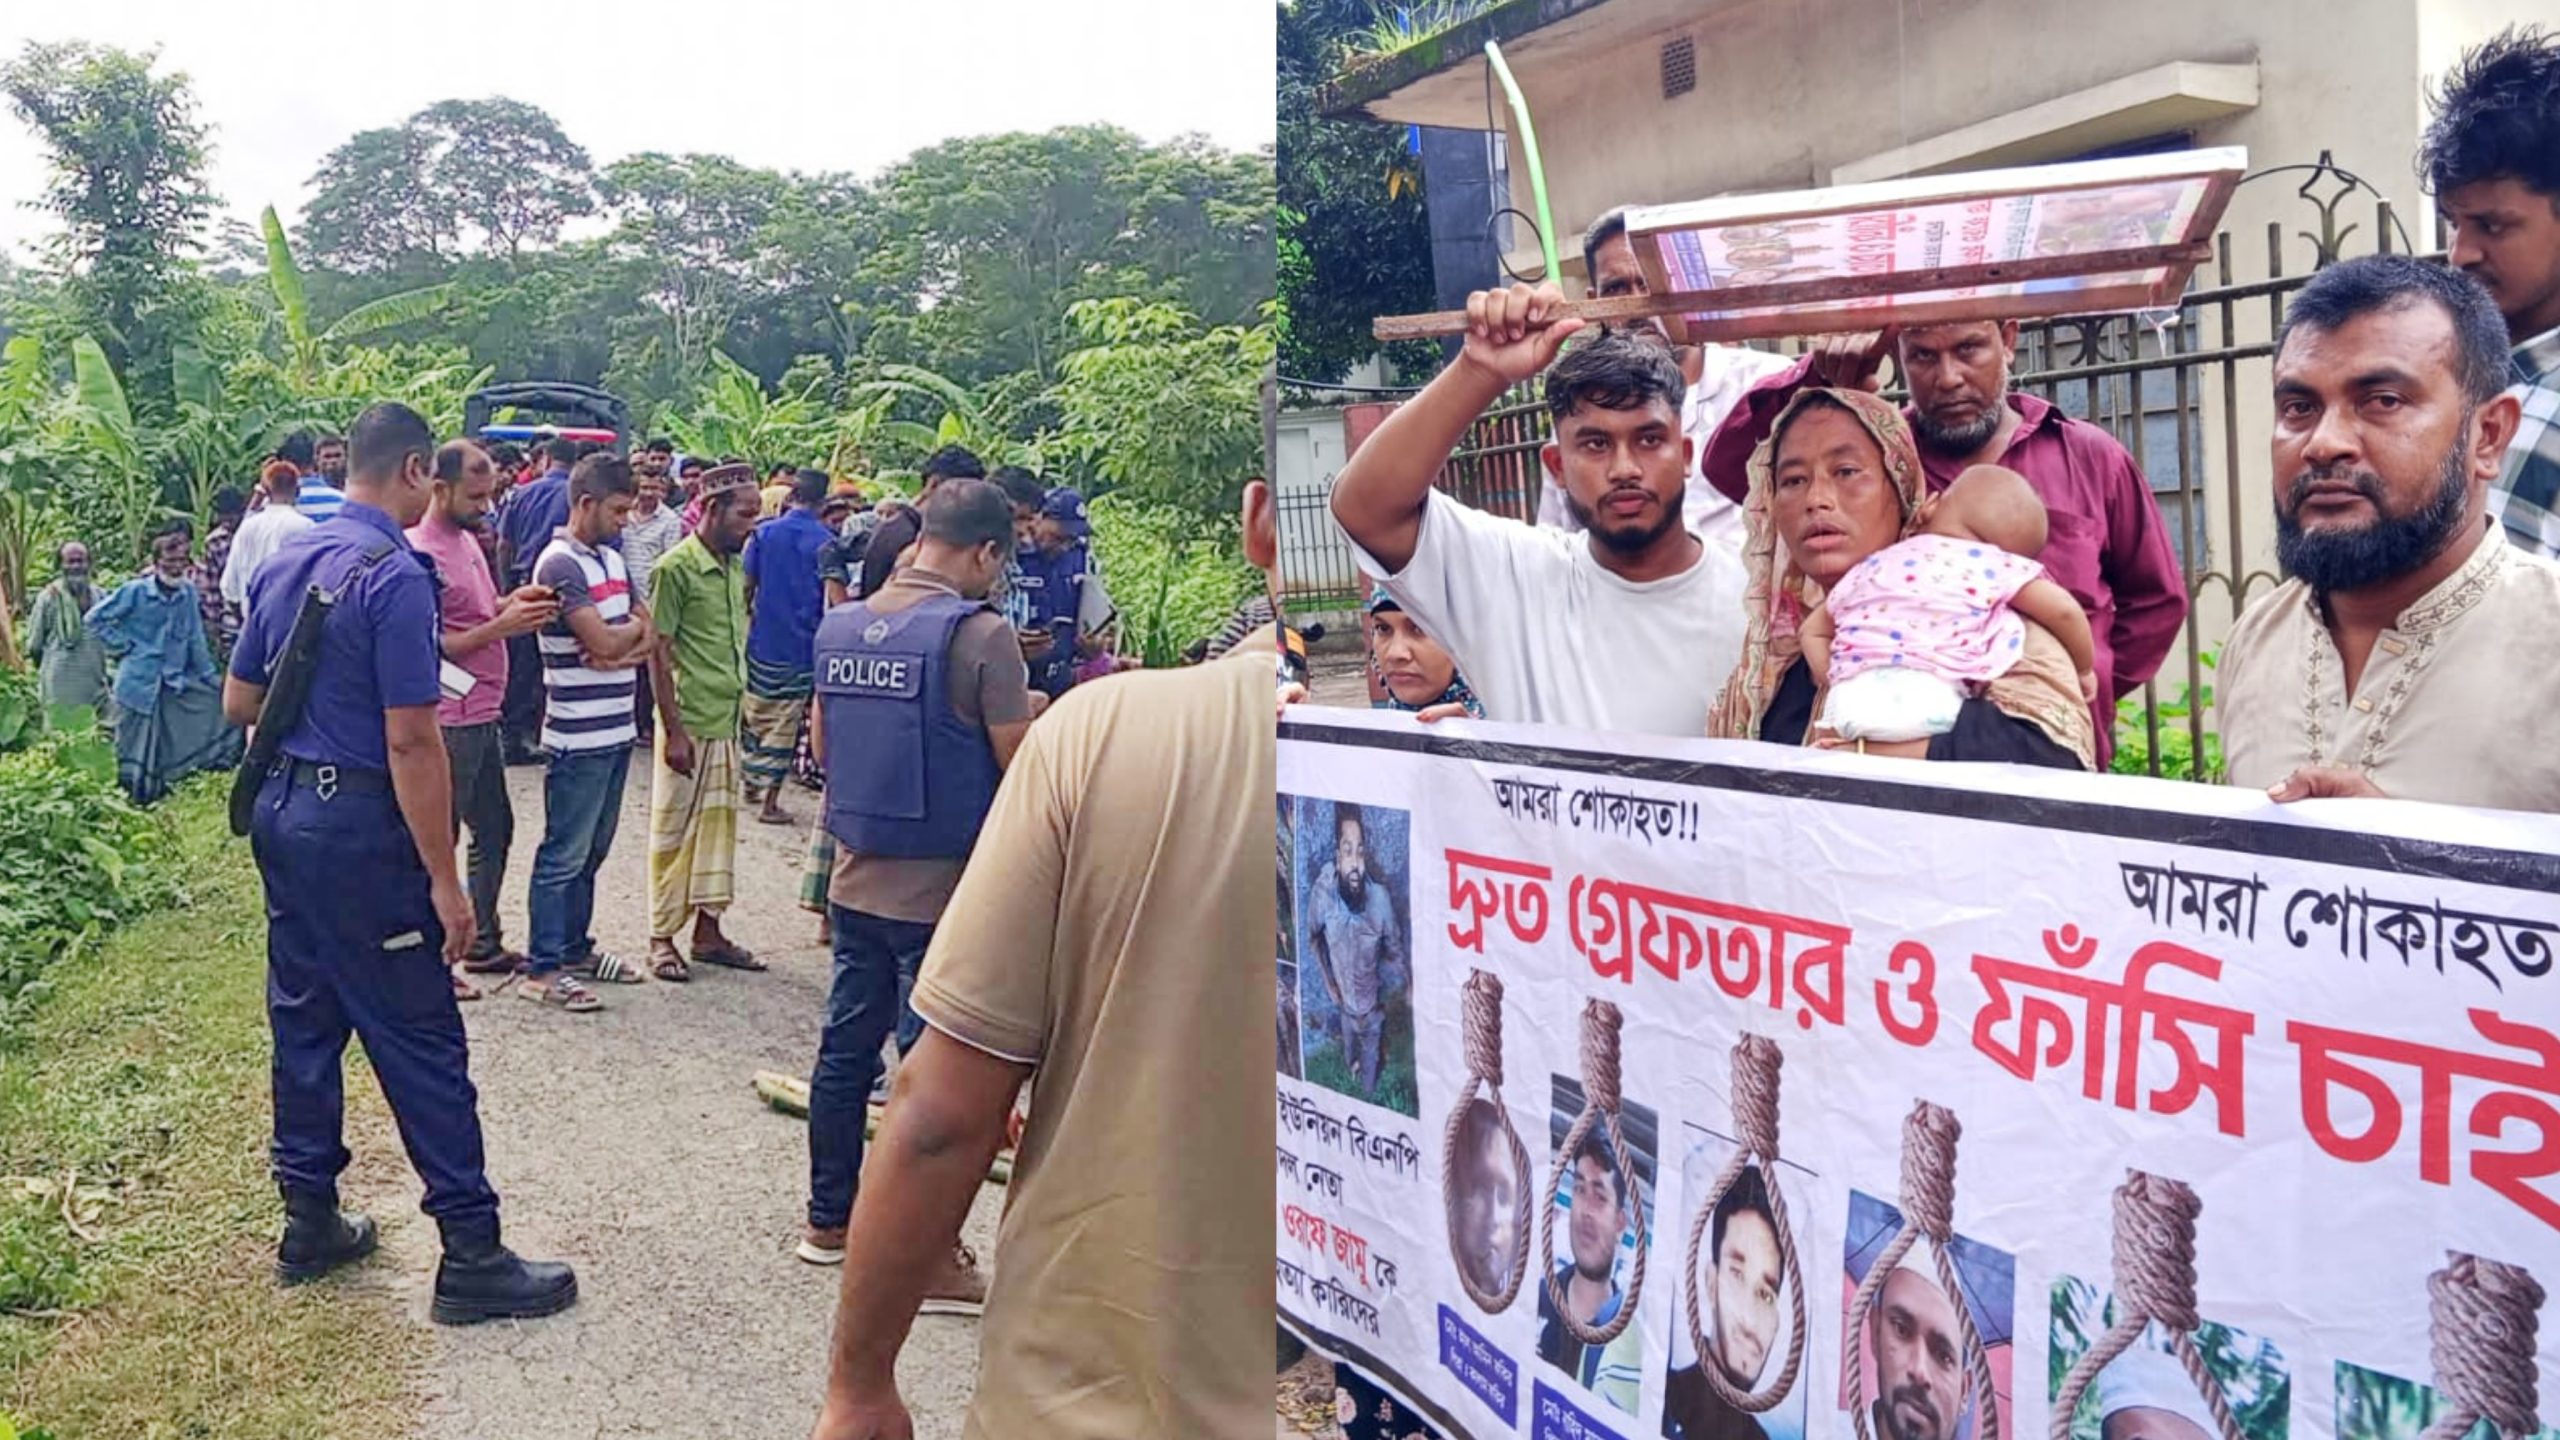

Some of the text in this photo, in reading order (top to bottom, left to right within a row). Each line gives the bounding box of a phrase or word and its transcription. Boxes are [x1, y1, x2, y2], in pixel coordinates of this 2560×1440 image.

[827, 657, 906, 688] POLICE
[1492, 775, 1698, 846] আমরা শোকাহত!!
[2118, 861, 2560, 994] আমরা শোকাহত
[1445, 848, 2560, 1233] দ্রুত গ্রেফতার ও ফাঁসি চাই
[1346, 1114, 1420, 1182] বিএনপি
[1372, 1253, 1397, 1296] কে
